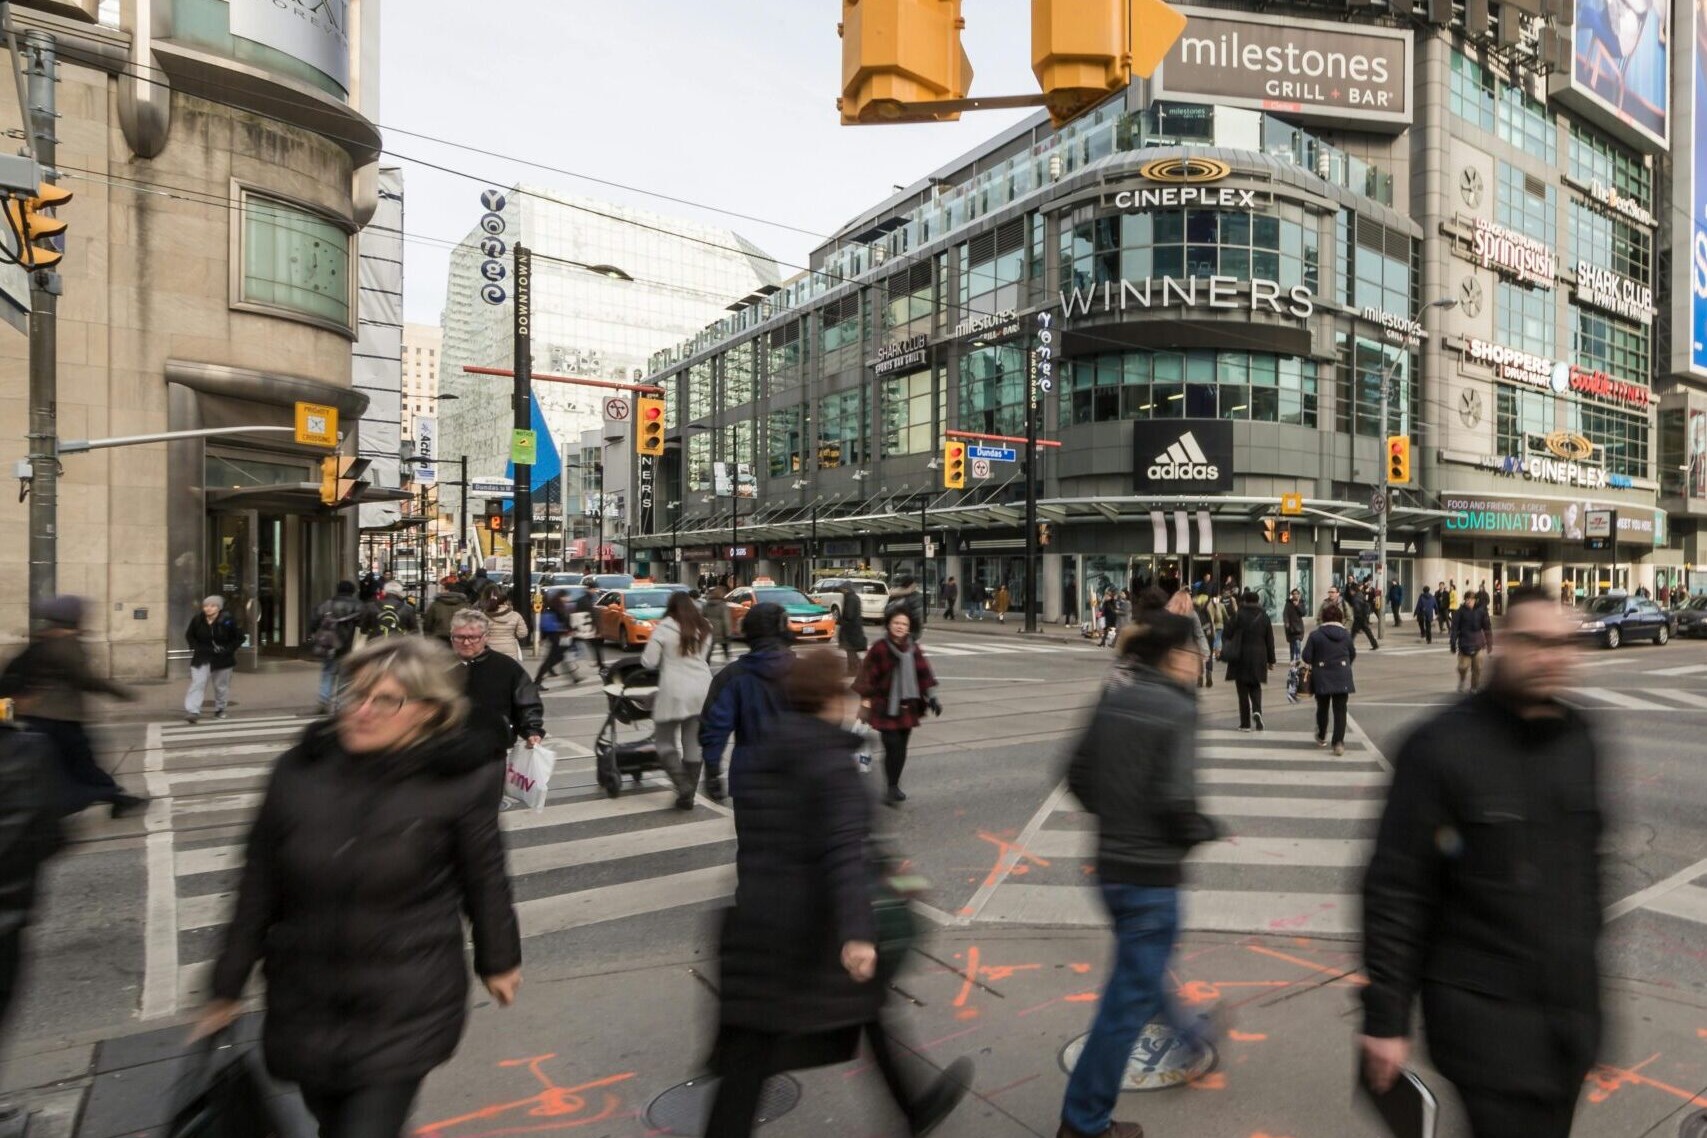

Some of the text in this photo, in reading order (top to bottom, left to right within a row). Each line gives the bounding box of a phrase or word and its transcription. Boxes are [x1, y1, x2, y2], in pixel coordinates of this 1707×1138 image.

[1181, 31, 1388, 84] milestones
[1265, 80, 1325, 101] GRILL
[1168, 107, 1206, 116] milestones
[1115, 188, 1256, 208] CINEPLEX
[518, 255, 529, 335] DOWNTOWN
[1059, 274, 1314, 319] WINNERS
[1578, 260, 1620, 300] SHARK
[1623, 279, 1652, 310] CLUB
[956, 308, 1017, 337] milestones
[1364, 305, 1421, 336] milestones
[878, 341, 903, 359] SHARK
[1470, 339, 1551, 375] SHOPPERS
[1504, 366, 1550, 388] DRUG MART
[420, 433, 431, 469] Actin
[977, 447, 1002, 458] Dundas
[1147, 461, 1219, 480] adidas
[1529, 458, 1607, 488] CINEPLEX
[1447, 500, 1468, 509] FOOD
[1469, 500, 1484, 510] AND
